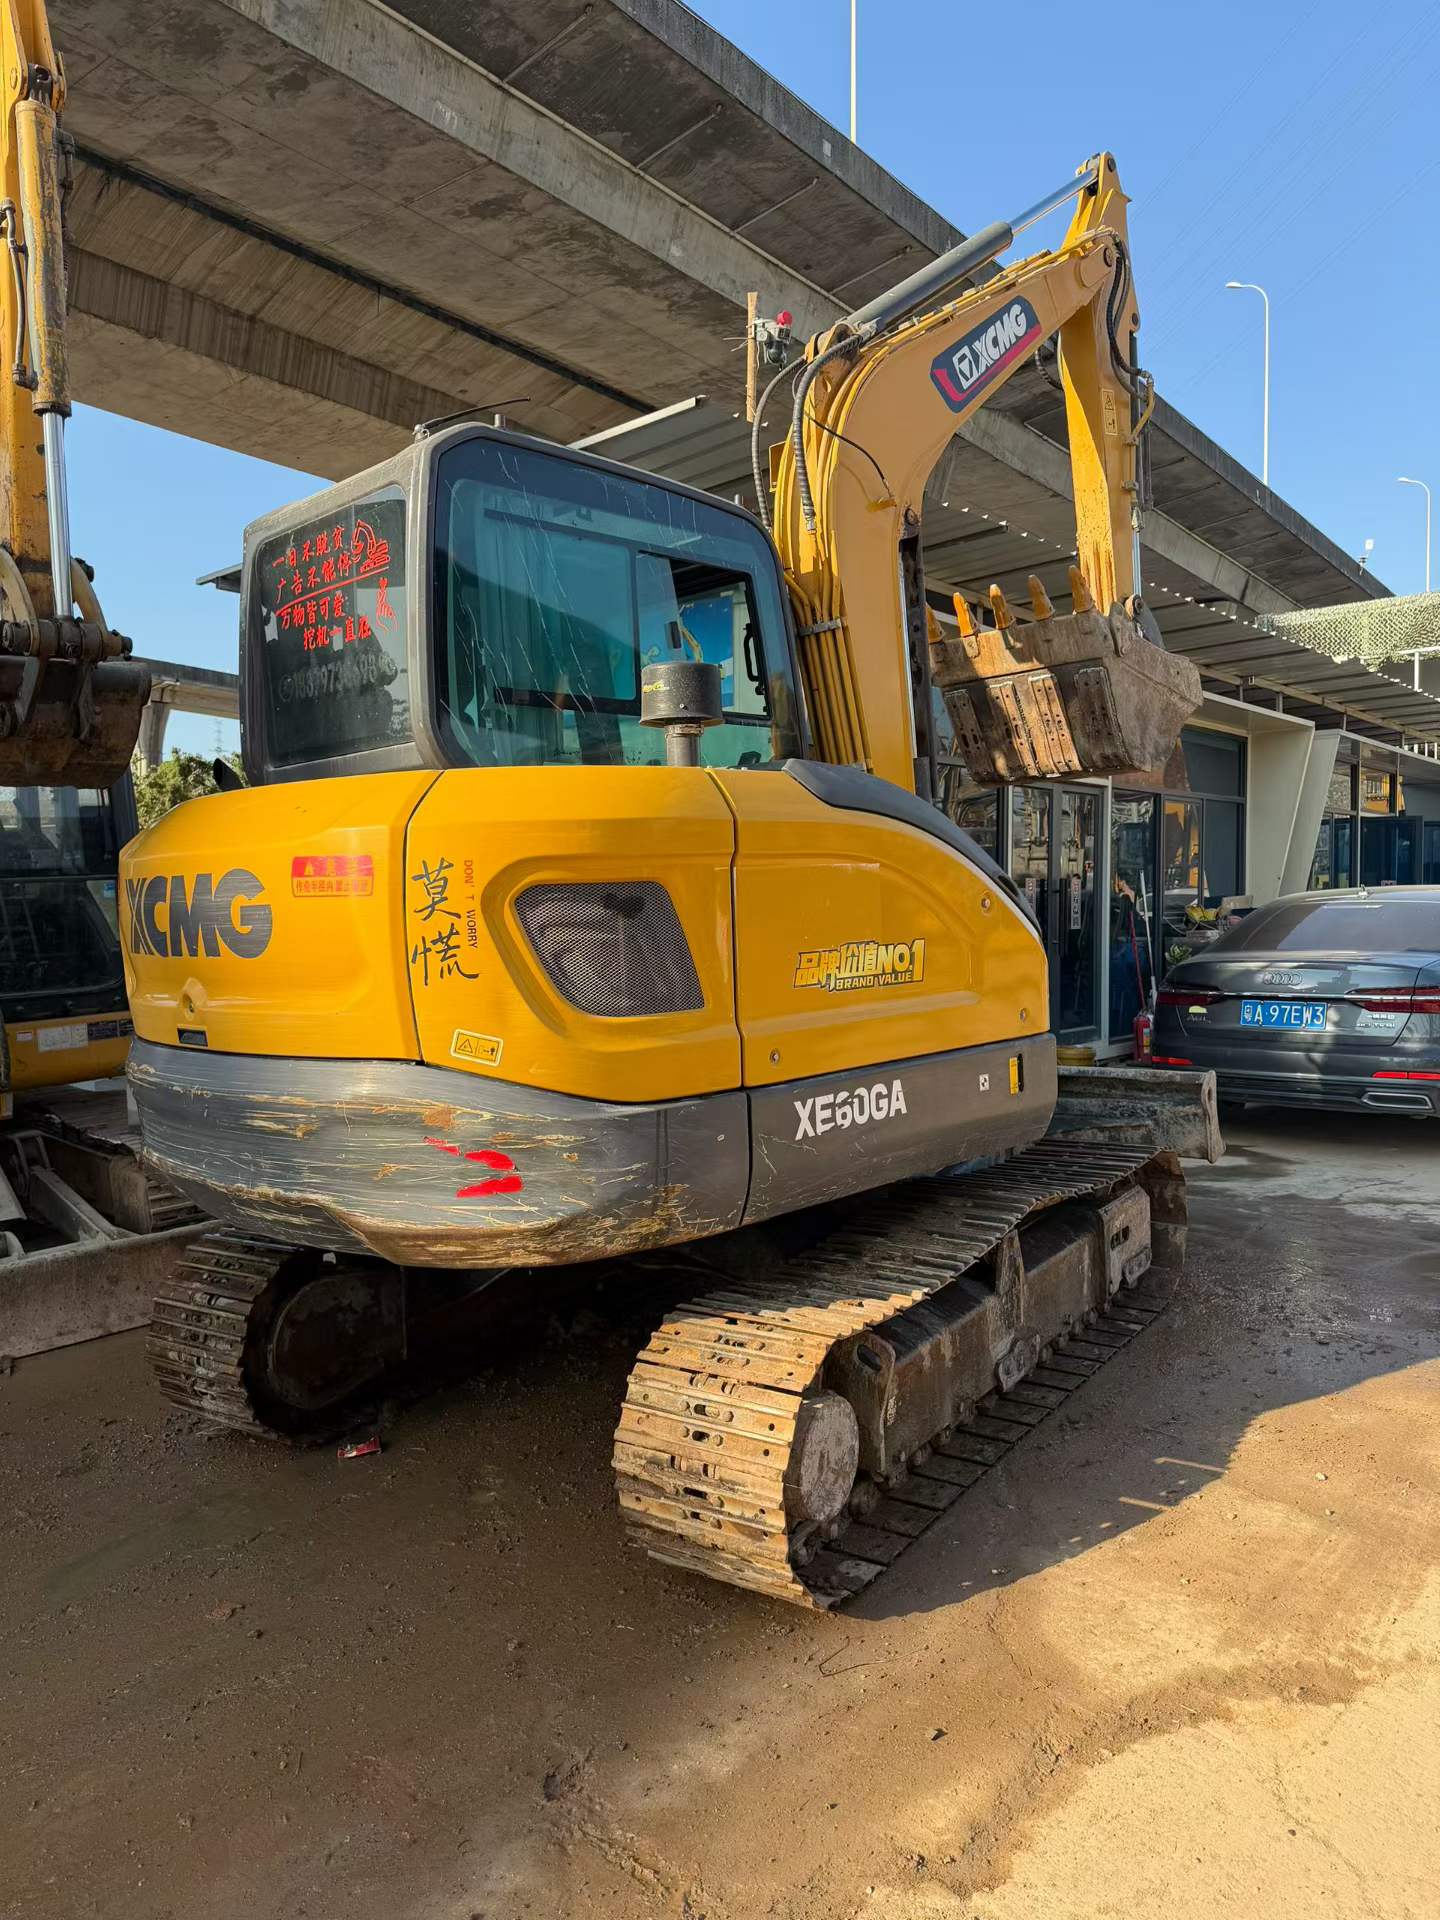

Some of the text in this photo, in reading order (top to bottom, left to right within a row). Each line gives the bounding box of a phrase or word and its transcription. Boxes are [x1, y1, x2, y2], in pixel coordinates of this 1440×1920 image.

[972, 304, 1027, 375] XCMG
[275, 552, 352, 604] 广告不能停
[125, 868, 272, 959] XCMG
[411, 857, 479, 986] 莫慌
[465, 909, 479, 949] WORRY
[836, 971, 912, 991] BRAND VALUE
[793, 1079, 908, 1141] XE60GA
